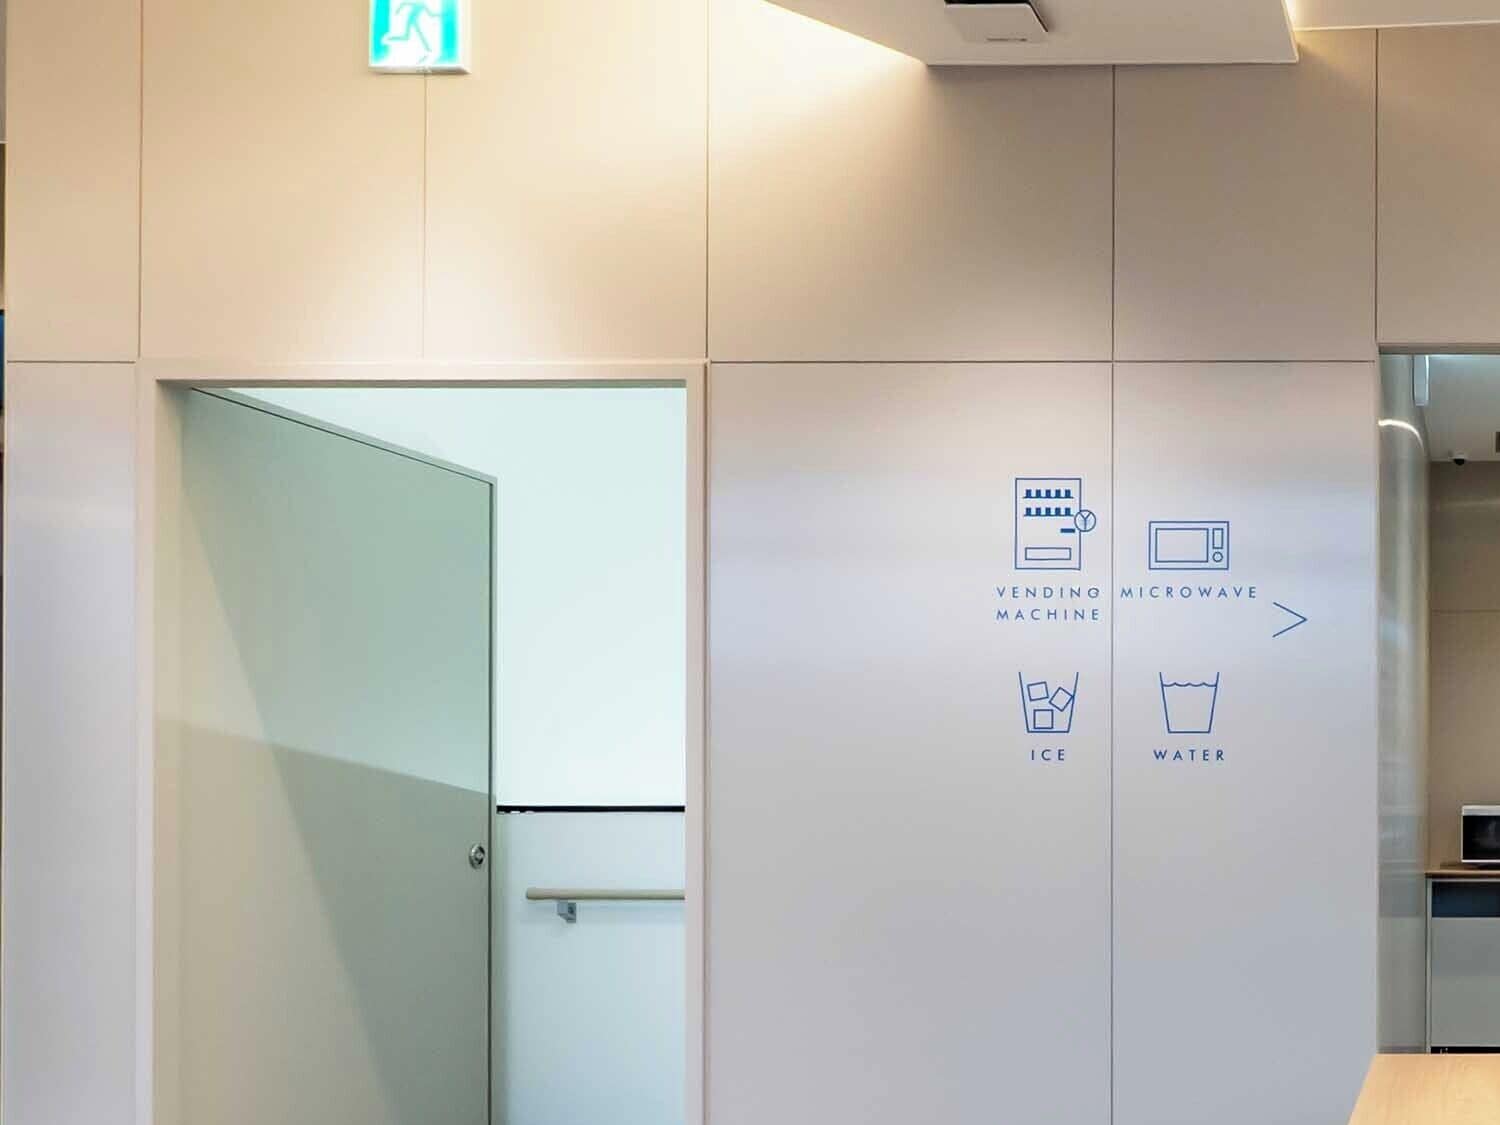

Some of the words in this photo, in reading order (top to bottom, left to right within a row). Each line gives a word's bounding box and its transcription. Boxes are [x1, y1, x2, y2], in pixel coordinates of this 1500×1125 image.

[996, 586, 1100, 599] VENDING
[1120, 586, 1256, 599] MICROWAVE
[996, 608, 1099, 621] MACHINE
[1031, 748, 1065, 761] ICE
[1153, 749, 1225, 762] WATER
